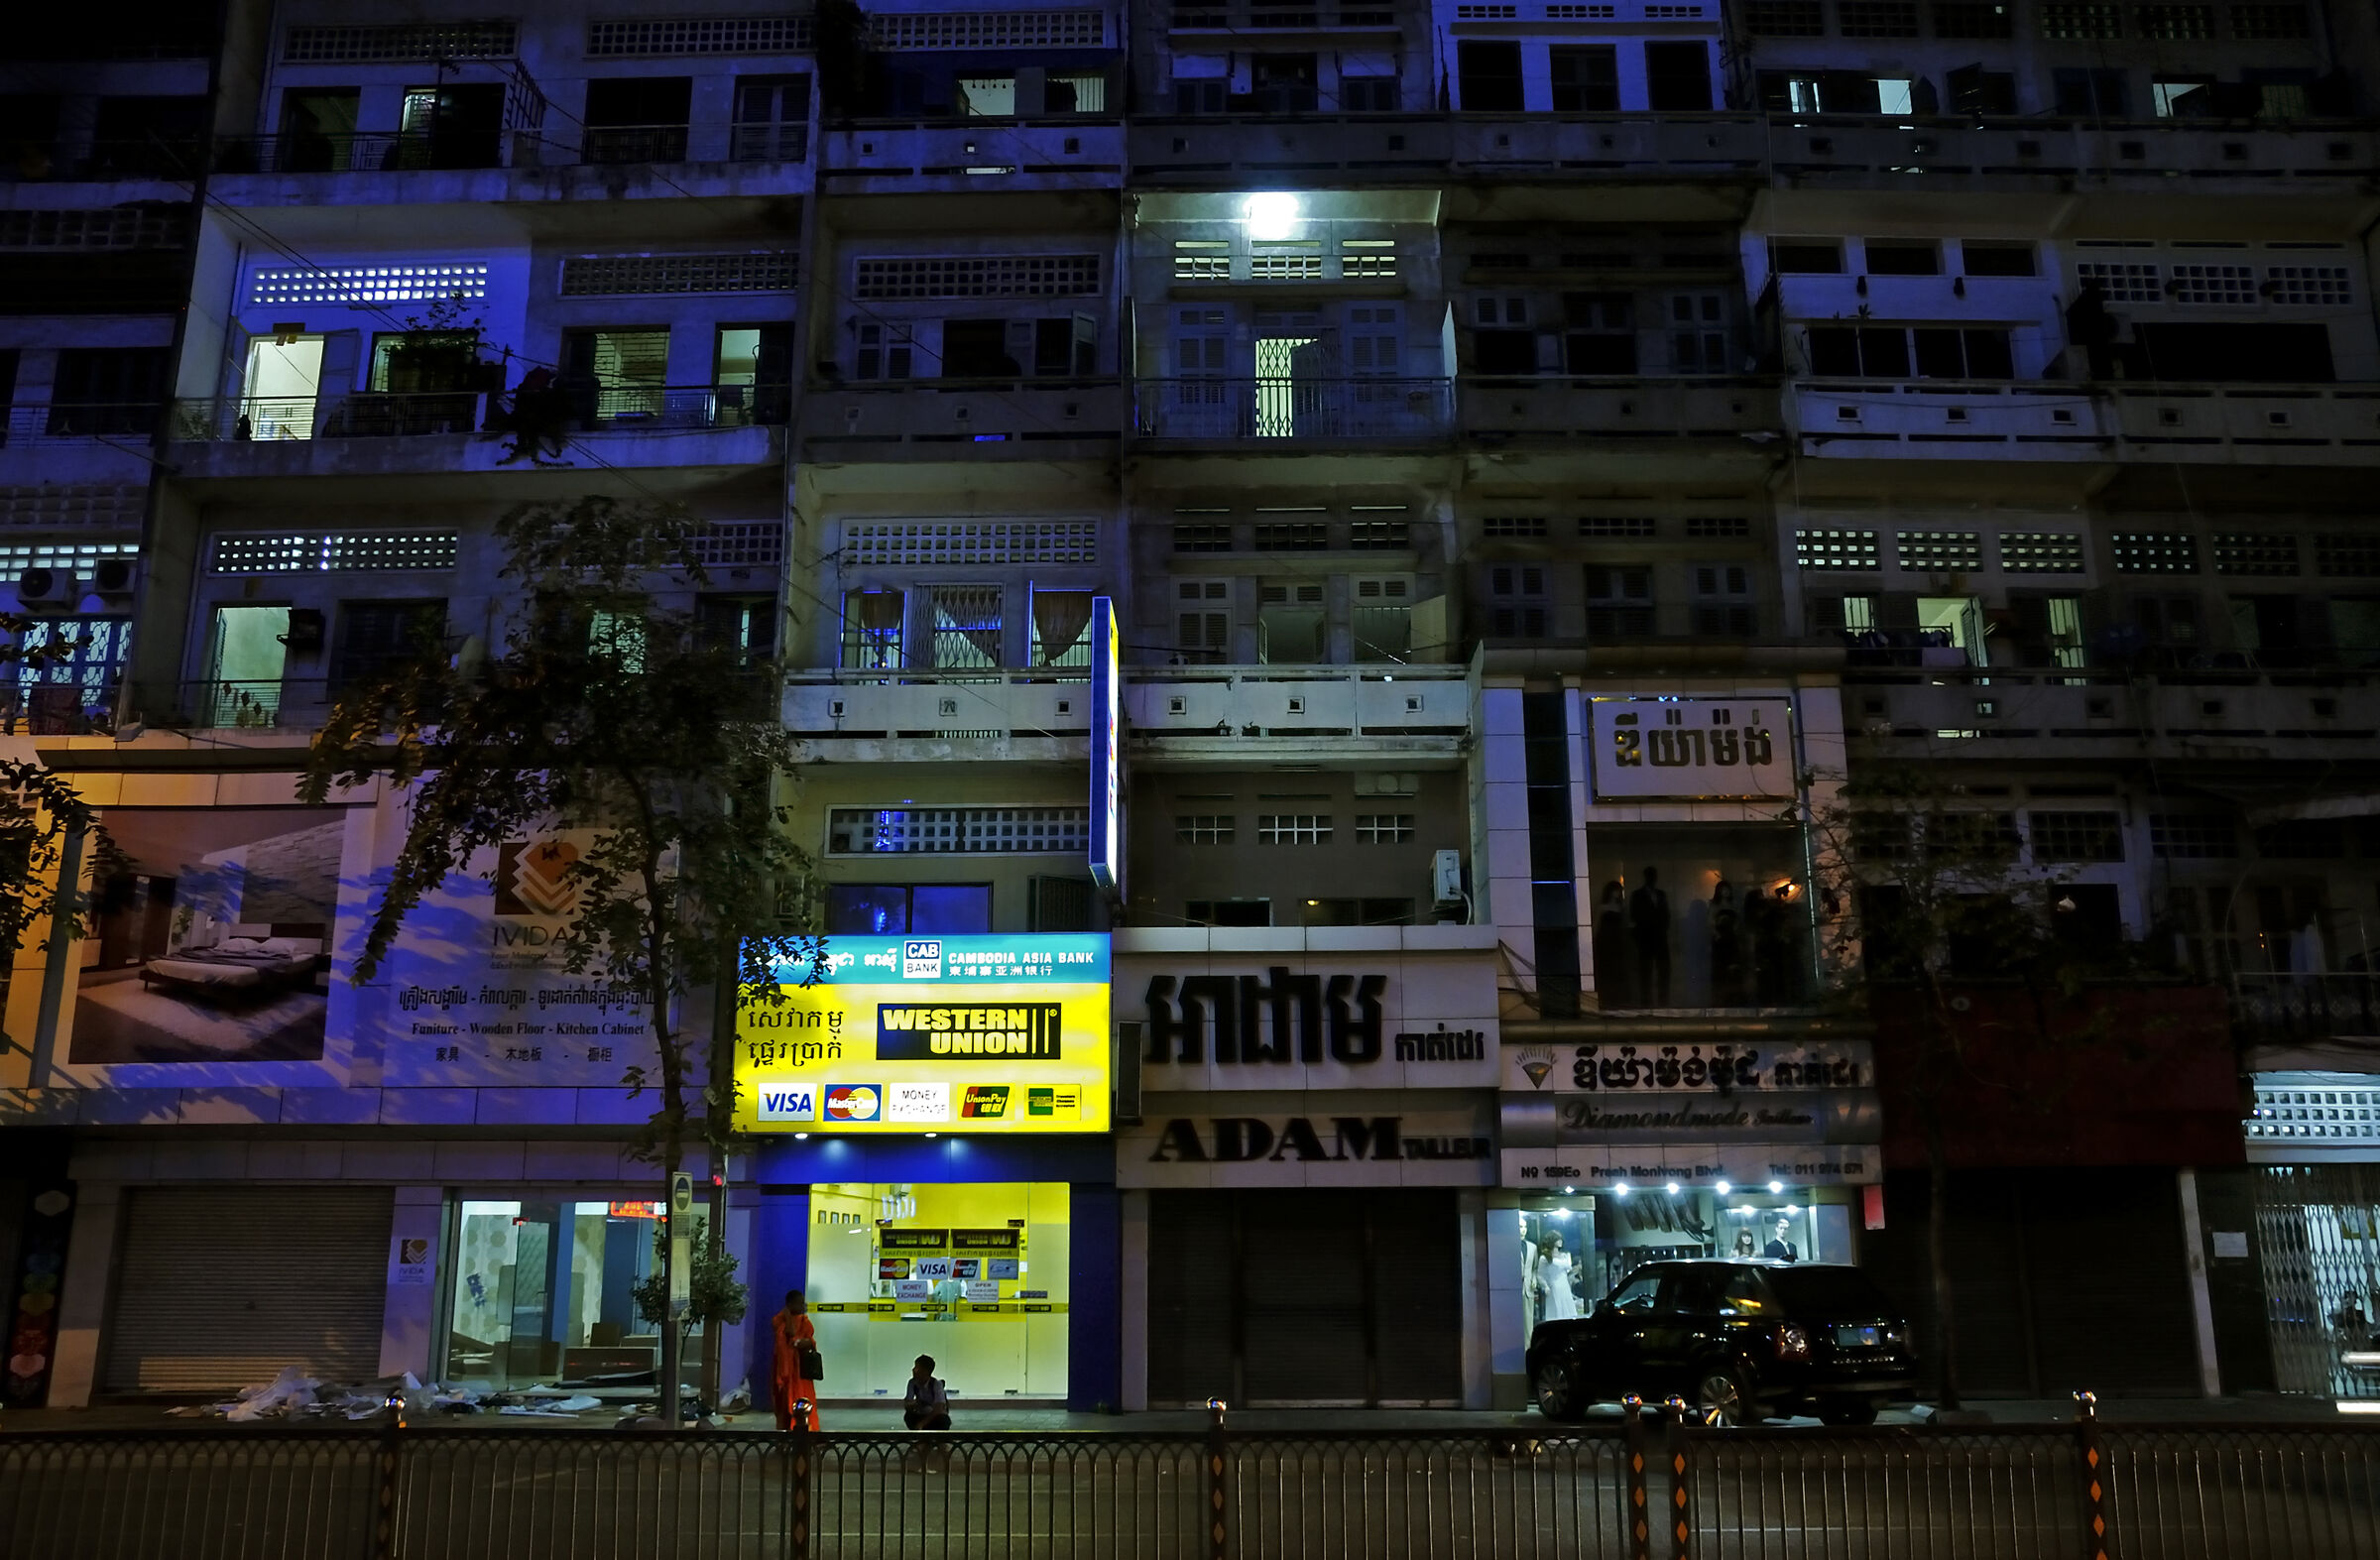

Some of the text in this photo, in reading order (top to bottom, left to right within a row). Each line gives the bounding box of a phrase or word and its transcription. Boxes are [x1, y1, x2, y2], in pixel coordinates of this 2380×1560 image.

[493, 925, 568, 946] IVIDA
[907, 943, 939, 958] CAB
[948, 952, 1094, 964] CAMBODIA ASIA BANK
[906, 962, 938, 973] BANK
[882, 1009, 1027, 1030] WESTERN
[412, 1022, 458, 1034] Funiture
[470, 1022, 513, 1034] Wooden
[517, 1022, 545, 1034] Floor
[556, 1022, 598, 1034] Kitchen
[602, 1022, 644, 1034] Cabinet
[930, 1032, 1027, 1053] UNION
[435, 1046, 459, 1062] 家具
[506, 1046, 542, 1062] 木地板
[901, 1089, 937, 1100] MONEY
[965, 1093, 1007, 1107] UnionPay
[764, 1093, 812, 1112] VISA
[1149, 1118, 1403, 1161] ADAM
[1630, 1165, 1692, 1180] Monivong
[919, 1263, 947, 1274] VISA
